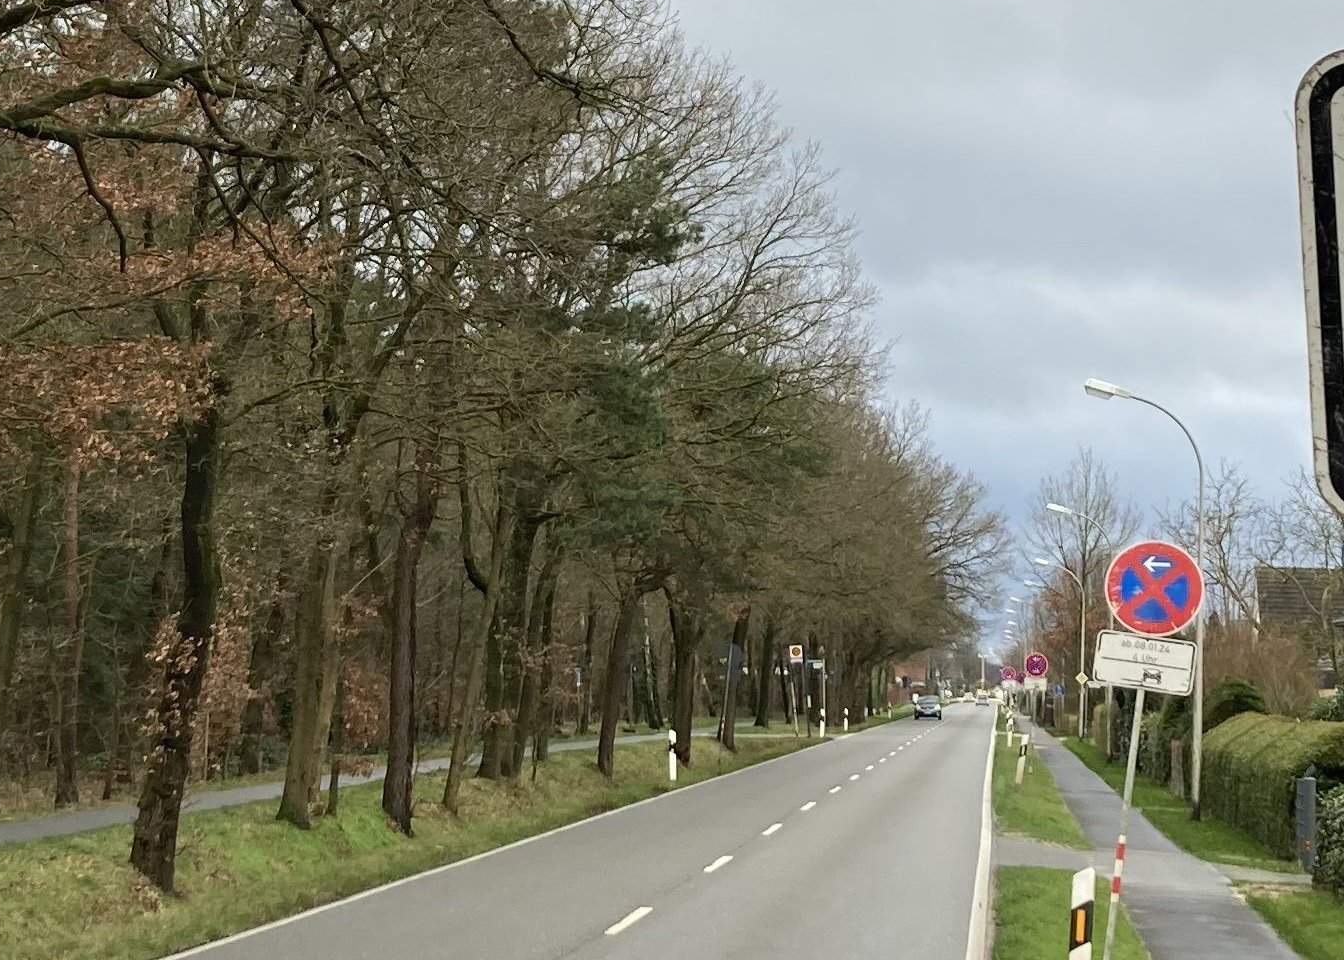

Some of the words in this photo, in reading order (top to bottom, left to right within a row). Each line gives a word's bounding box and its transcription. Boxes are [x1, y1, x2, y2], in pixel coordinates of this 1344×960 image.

[1121, 639, 1131, 647] ab
[1135, 640, 1170, 653] 08.01.24
[1142, 653, 1158, 662] Uhr
